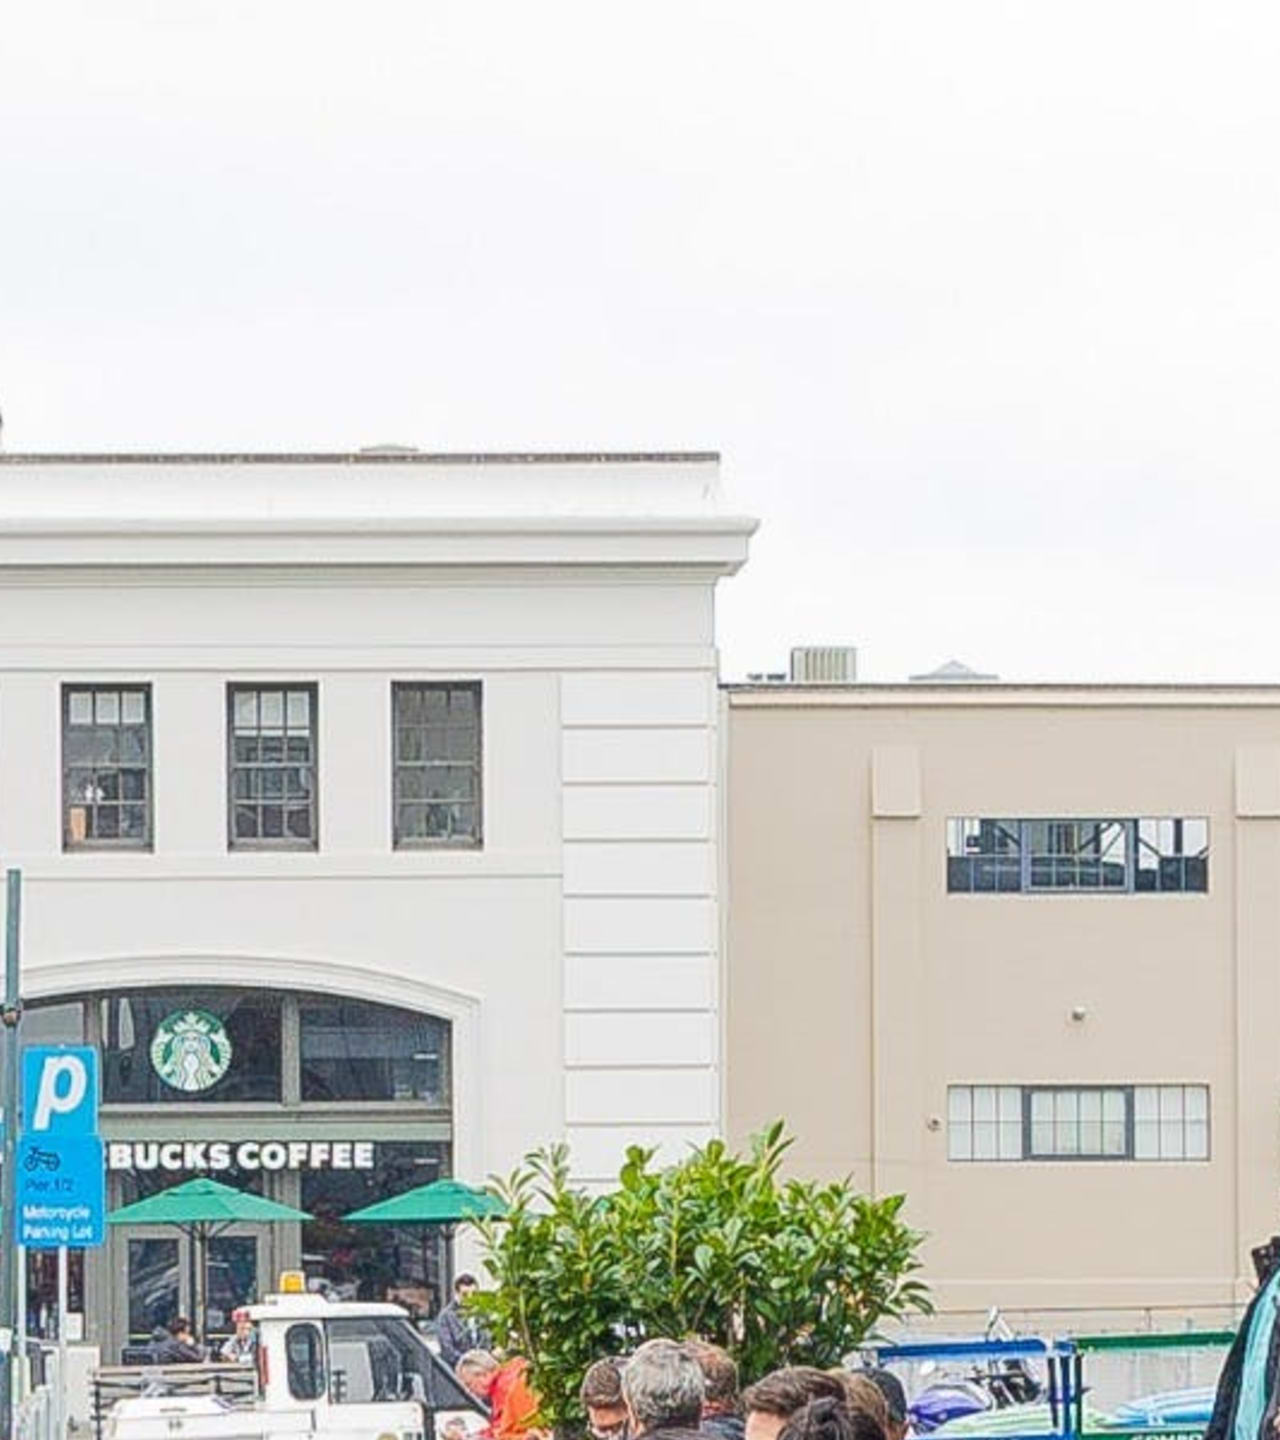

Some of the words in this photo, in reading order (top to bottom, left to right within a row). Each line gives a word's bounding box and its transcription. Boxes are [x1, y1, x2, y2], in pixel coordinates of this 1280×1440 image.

[237, 1143, 374, 1170] COFFEE
[23, 1205, 90, 1222] Motorcycle
[23, 1224, 70, 1241] Parking
[73, 1225, 93, 1239] Lot
